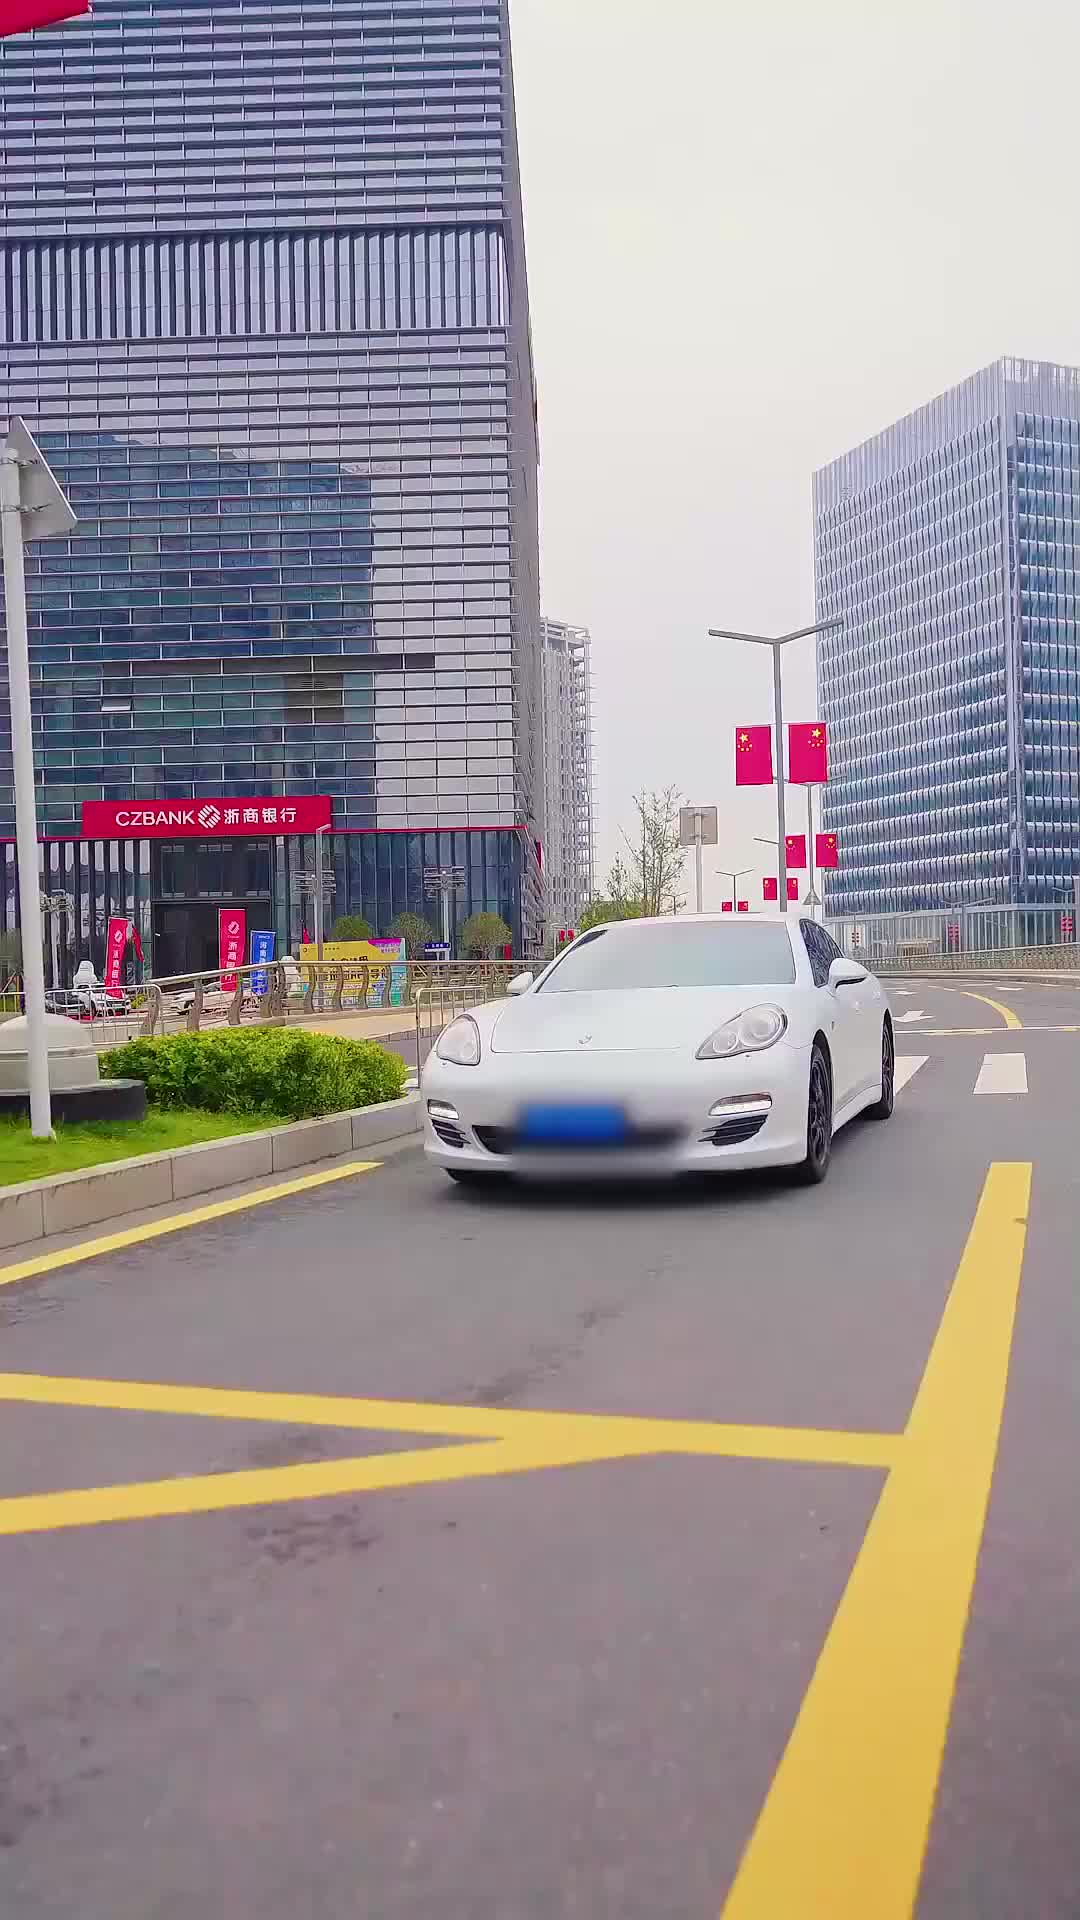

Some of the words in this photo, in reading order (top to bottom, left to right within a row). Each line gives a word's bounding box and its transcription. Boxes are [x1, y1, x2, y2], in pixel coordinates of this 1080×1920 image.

[115, 810, 196, 827] CZBANK
[223, 807, 297, 825] 浙商银行
